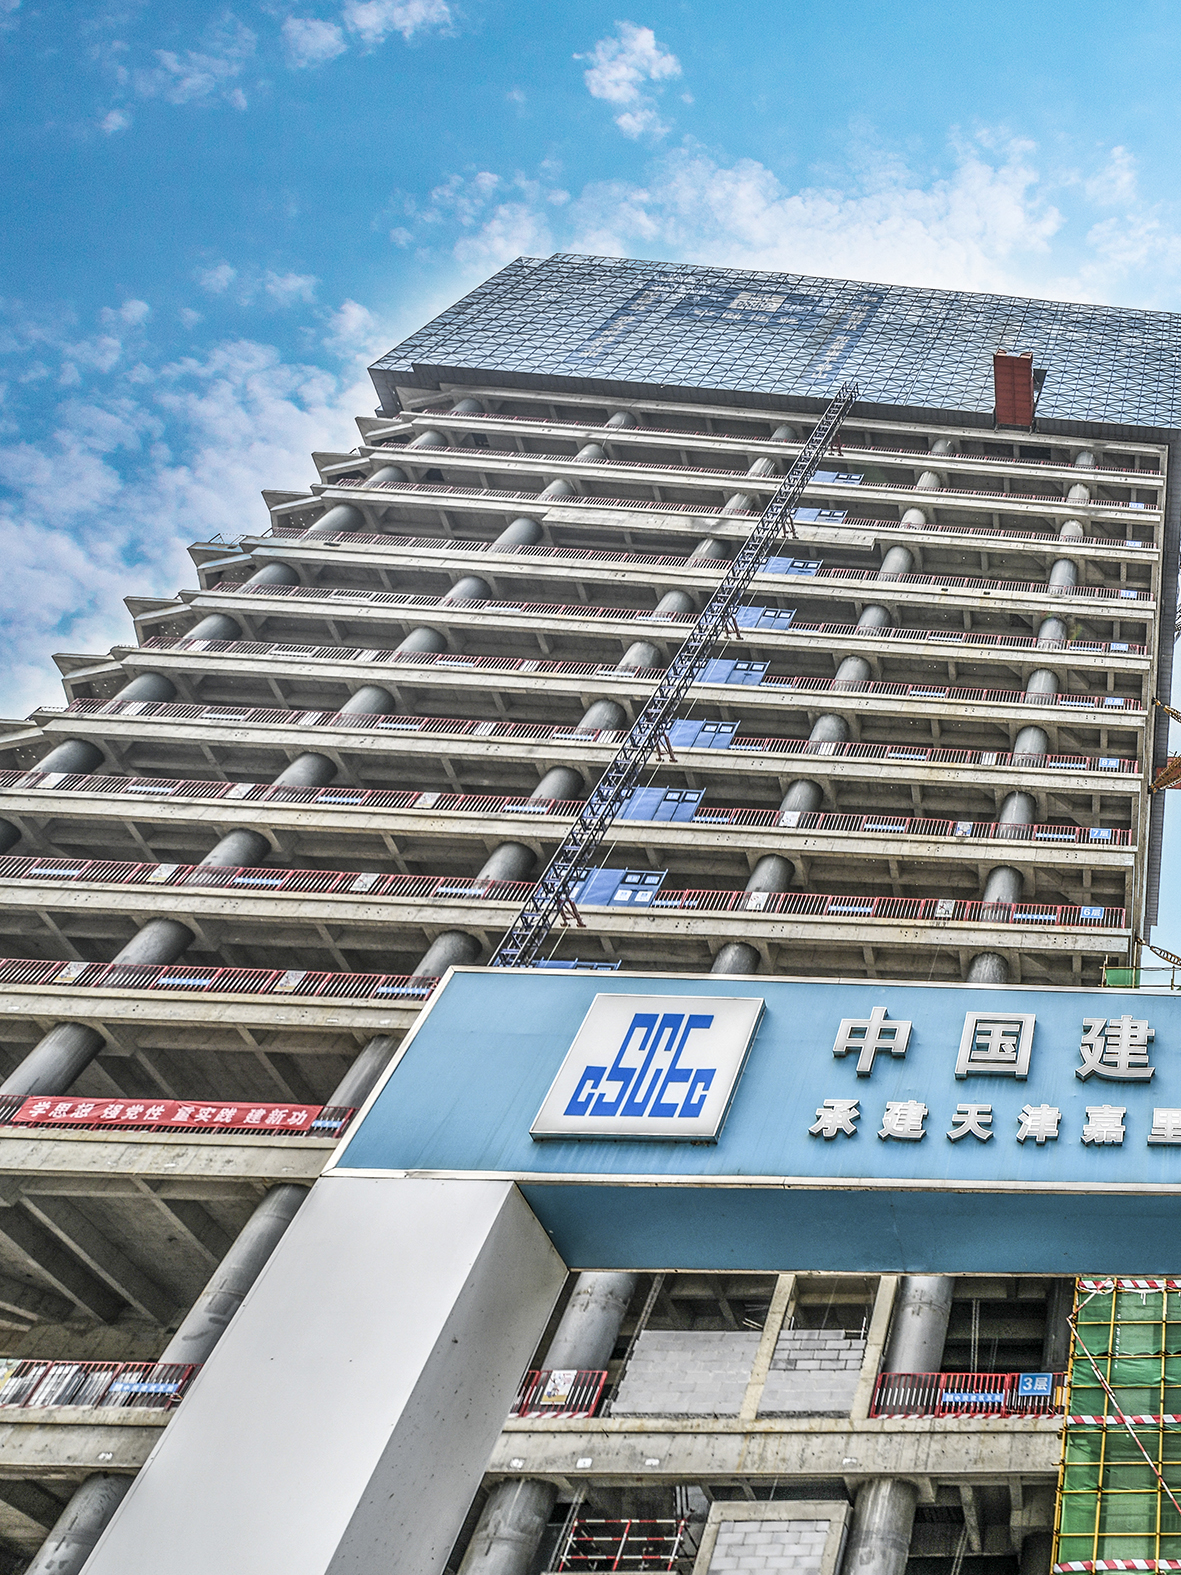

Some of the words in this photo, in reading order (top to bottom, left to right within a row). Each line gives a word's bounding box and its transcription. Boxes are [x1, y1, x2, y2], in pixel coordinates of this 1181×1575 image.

[1101, 759, 1117, 767] 8层
[1092, 829, 1109, 838] 7层
[1083, 908, 1102, 918] 6层
[28, 1101, 91, 1118] 学思想
[100, 1104, 166, 1121] 强党性
[171, 1106, 236, 1123] 重实践
[242, 1108, 309, 1126] 建新功
[1022, 1377, 1049, 1391] 3层
